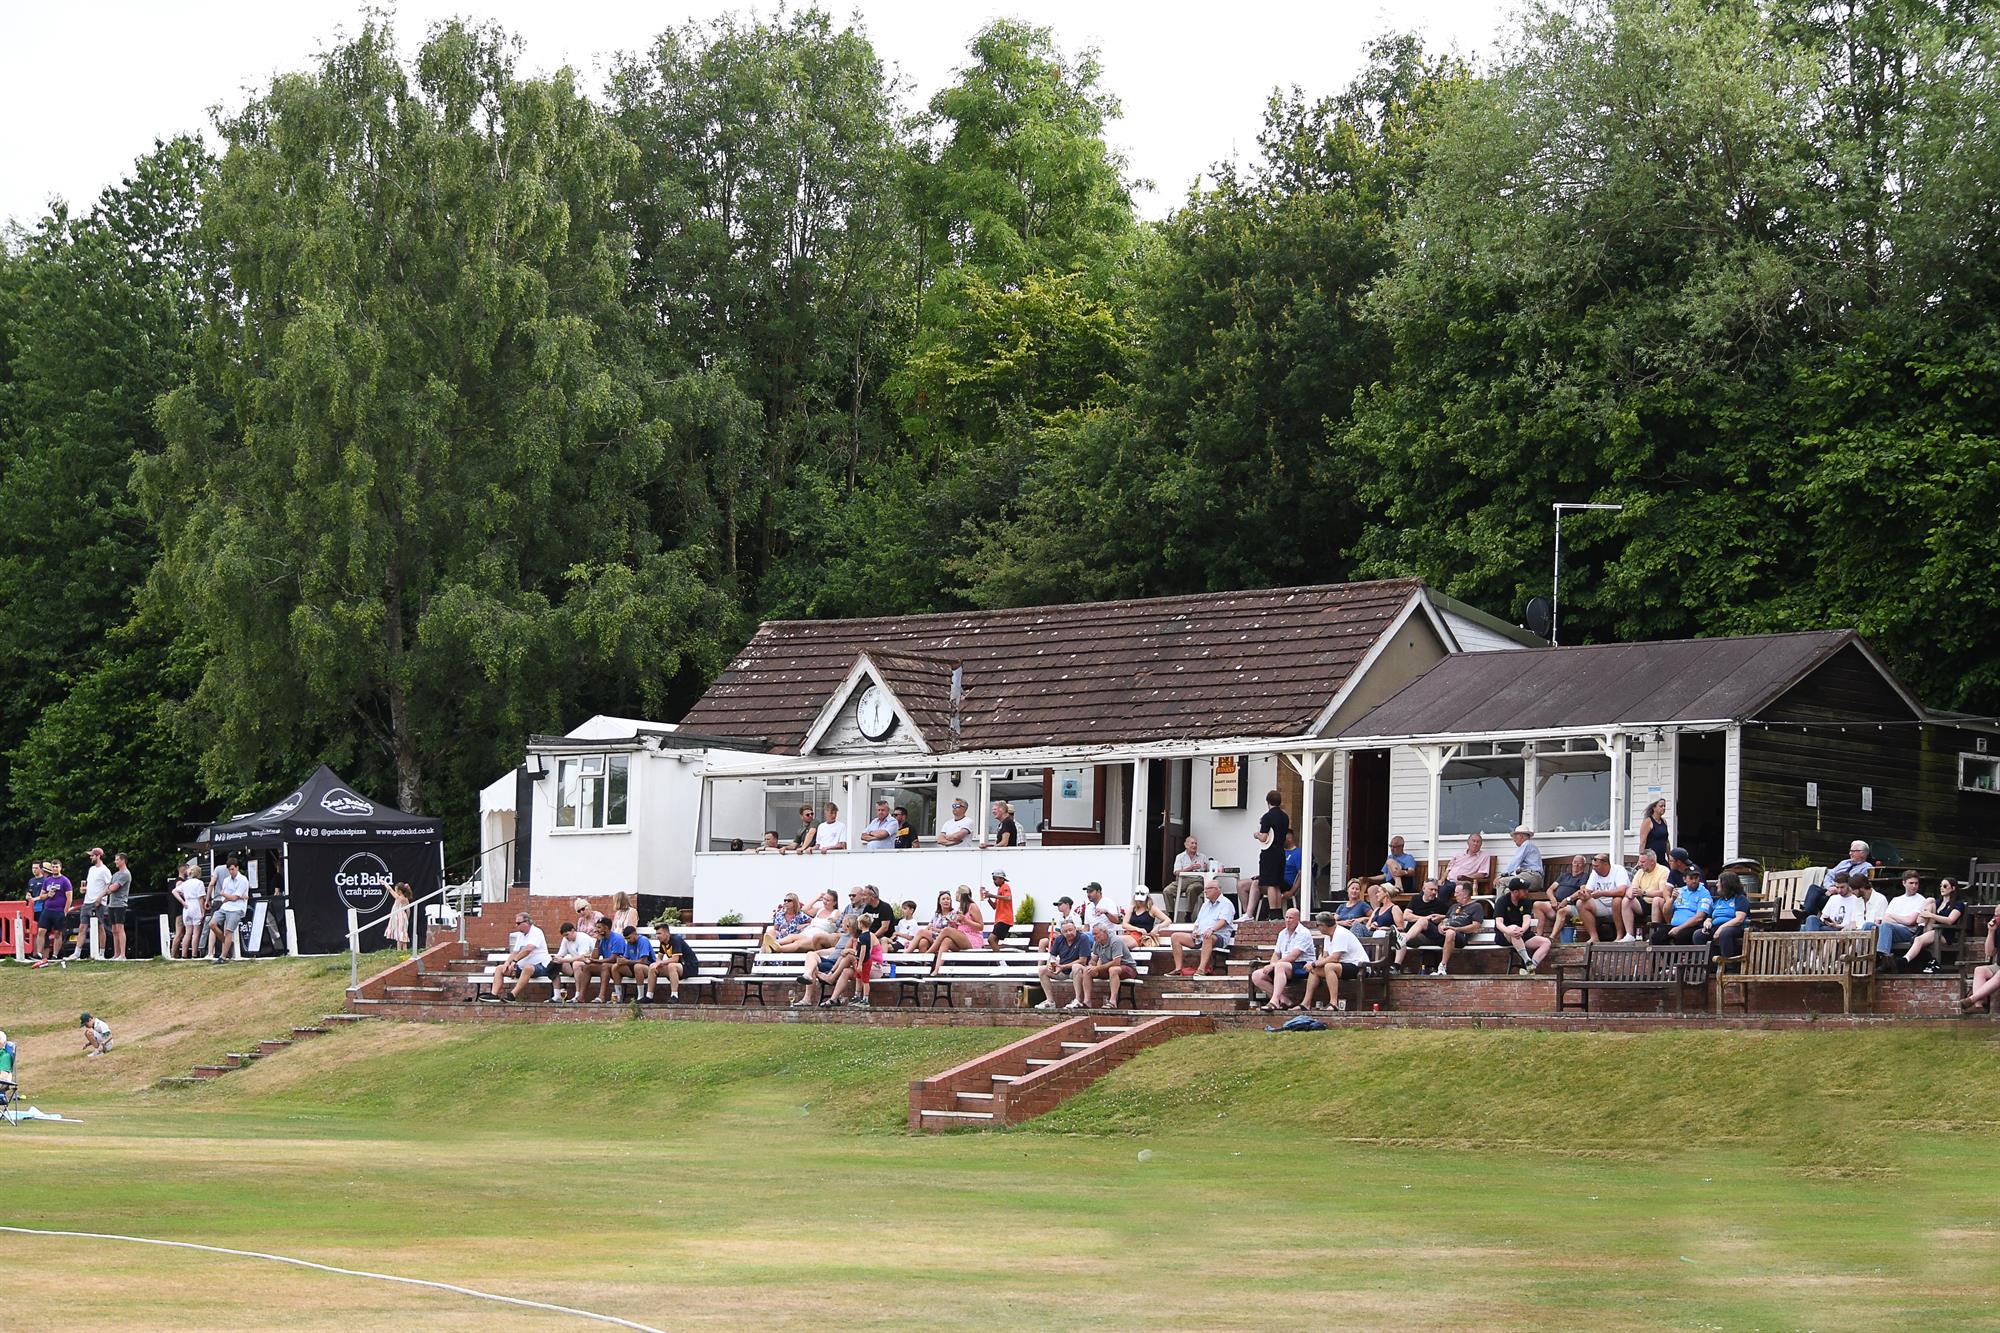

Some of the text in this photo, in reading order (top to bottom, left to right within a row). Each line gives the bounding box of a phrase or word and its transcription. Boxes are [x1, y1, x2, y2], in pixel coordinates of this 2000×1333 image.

[376, 827, 435, 836] www.getbakd.co.uk
[335, 872, 394, 886] Get Bakd
[345, 887, 382, 898] craft pizza
